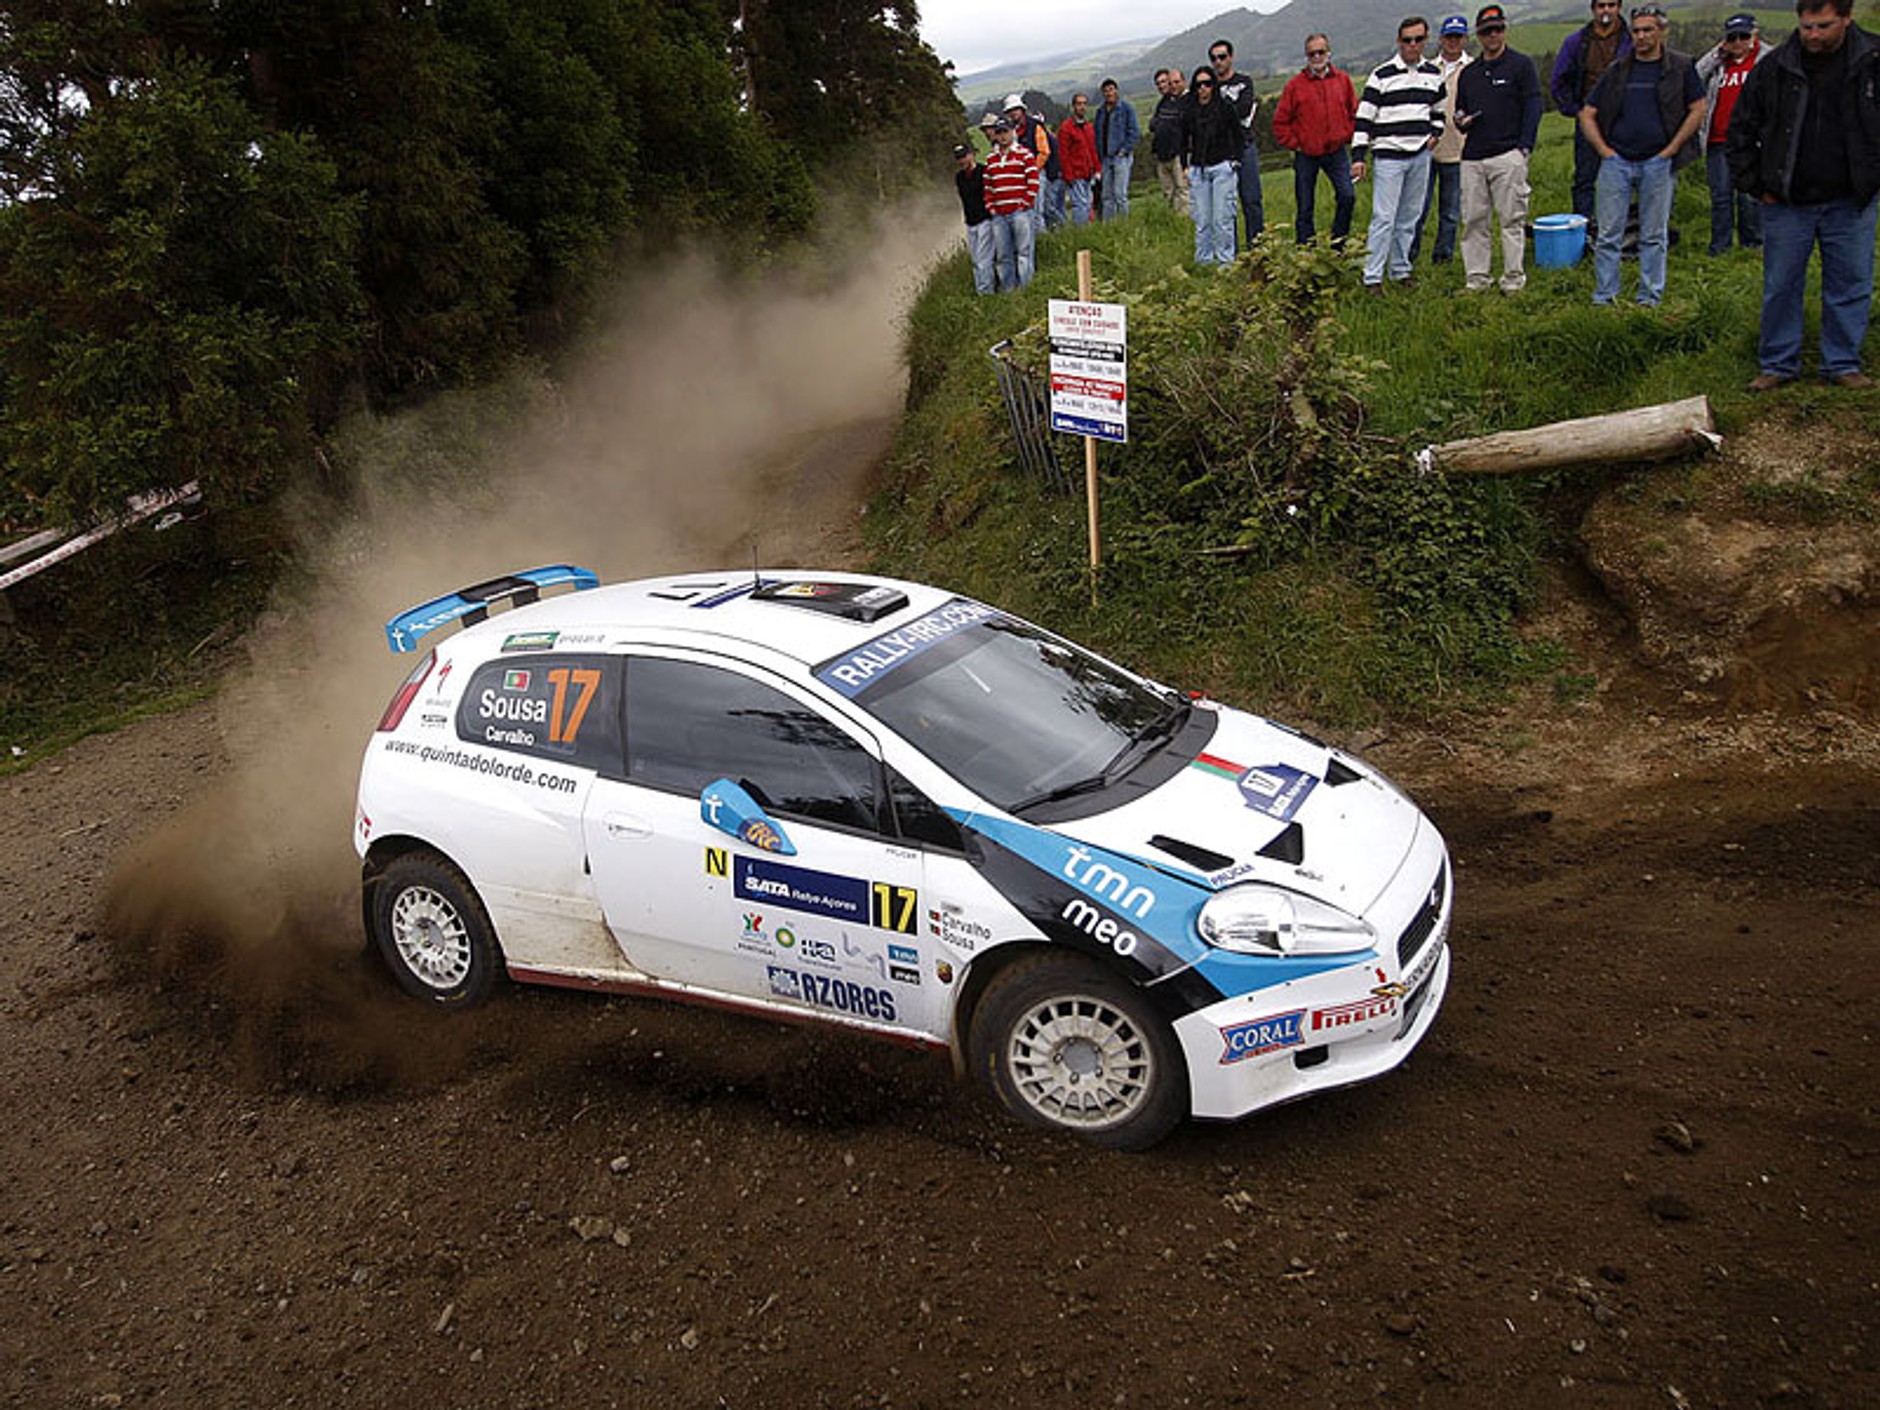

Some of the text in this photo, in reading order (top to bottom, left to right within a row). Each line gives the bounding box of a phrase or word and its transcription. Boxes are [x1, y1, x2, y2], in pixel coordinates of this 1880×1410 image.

[479, 689, 546, 722] Sousa
[547, 668, 602, 743] 17
[486, 725, 535, 746] Carvalho
[385, 739, 577, 794] www.quintadolorde.com
[706, 849, 727, 876] N
[744, 876, 790, 897] SATA
[1063, 846, 1156, 919] tmn
[873, 883, 917, 933] 17
[942, 911, 992, 940] Carvalho
[942, 927, 974, 951] Sousa
[1062, 899, 1137, 957] meo
[801, 973, 896, 1021] AZORES
[1312, 994, 1396, 1030] PIRELLI
[1230, 1018, 1296, 1051] CORAL
